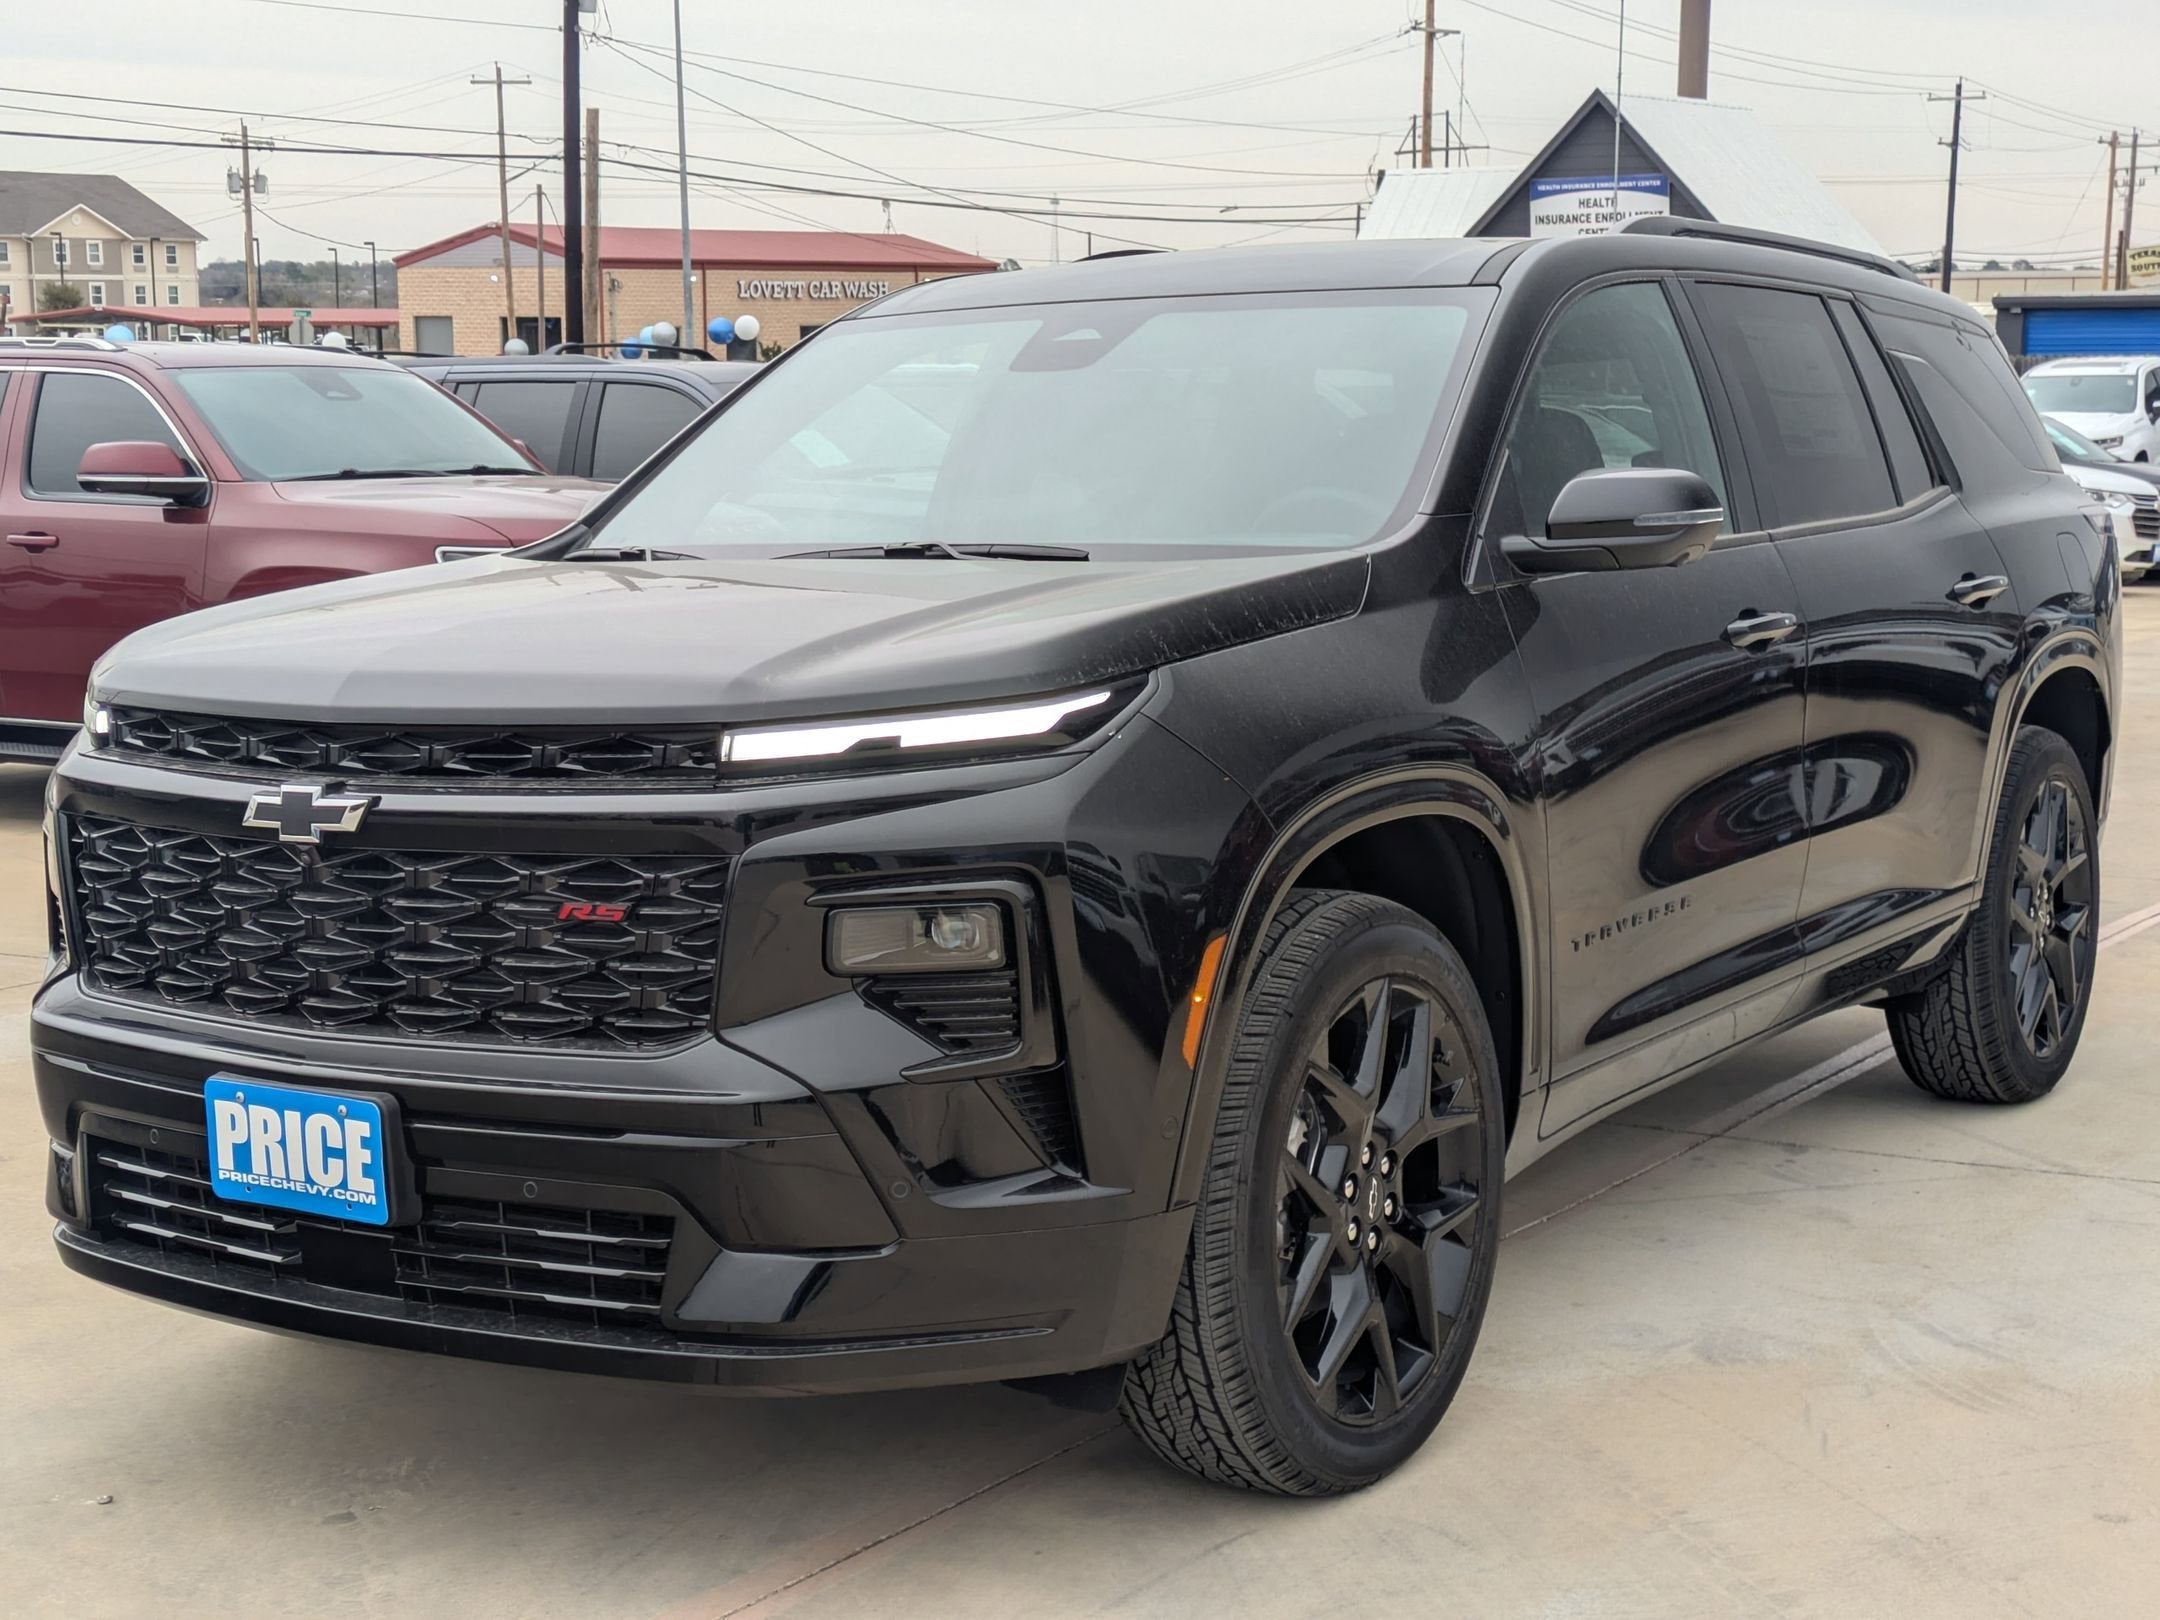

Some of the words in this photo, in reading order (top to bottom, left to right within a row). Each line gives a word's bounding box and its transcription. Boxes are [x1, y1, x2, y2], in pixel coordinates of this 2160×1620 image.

[1535, 213, 1592, 225] INSURANCE
[738, 280, 806, 300] LOVETT
[809, 280, 842, 299] CAR
[843, 280, 890, 299] WASH
[558, 901, 630, 922] RS
[1571, 895, 1694, 952] TRAVERSE
[213, 1099, 376, 1195] PRICE
[218, 1169, 377, 1206] PRICECHEVY.COM
